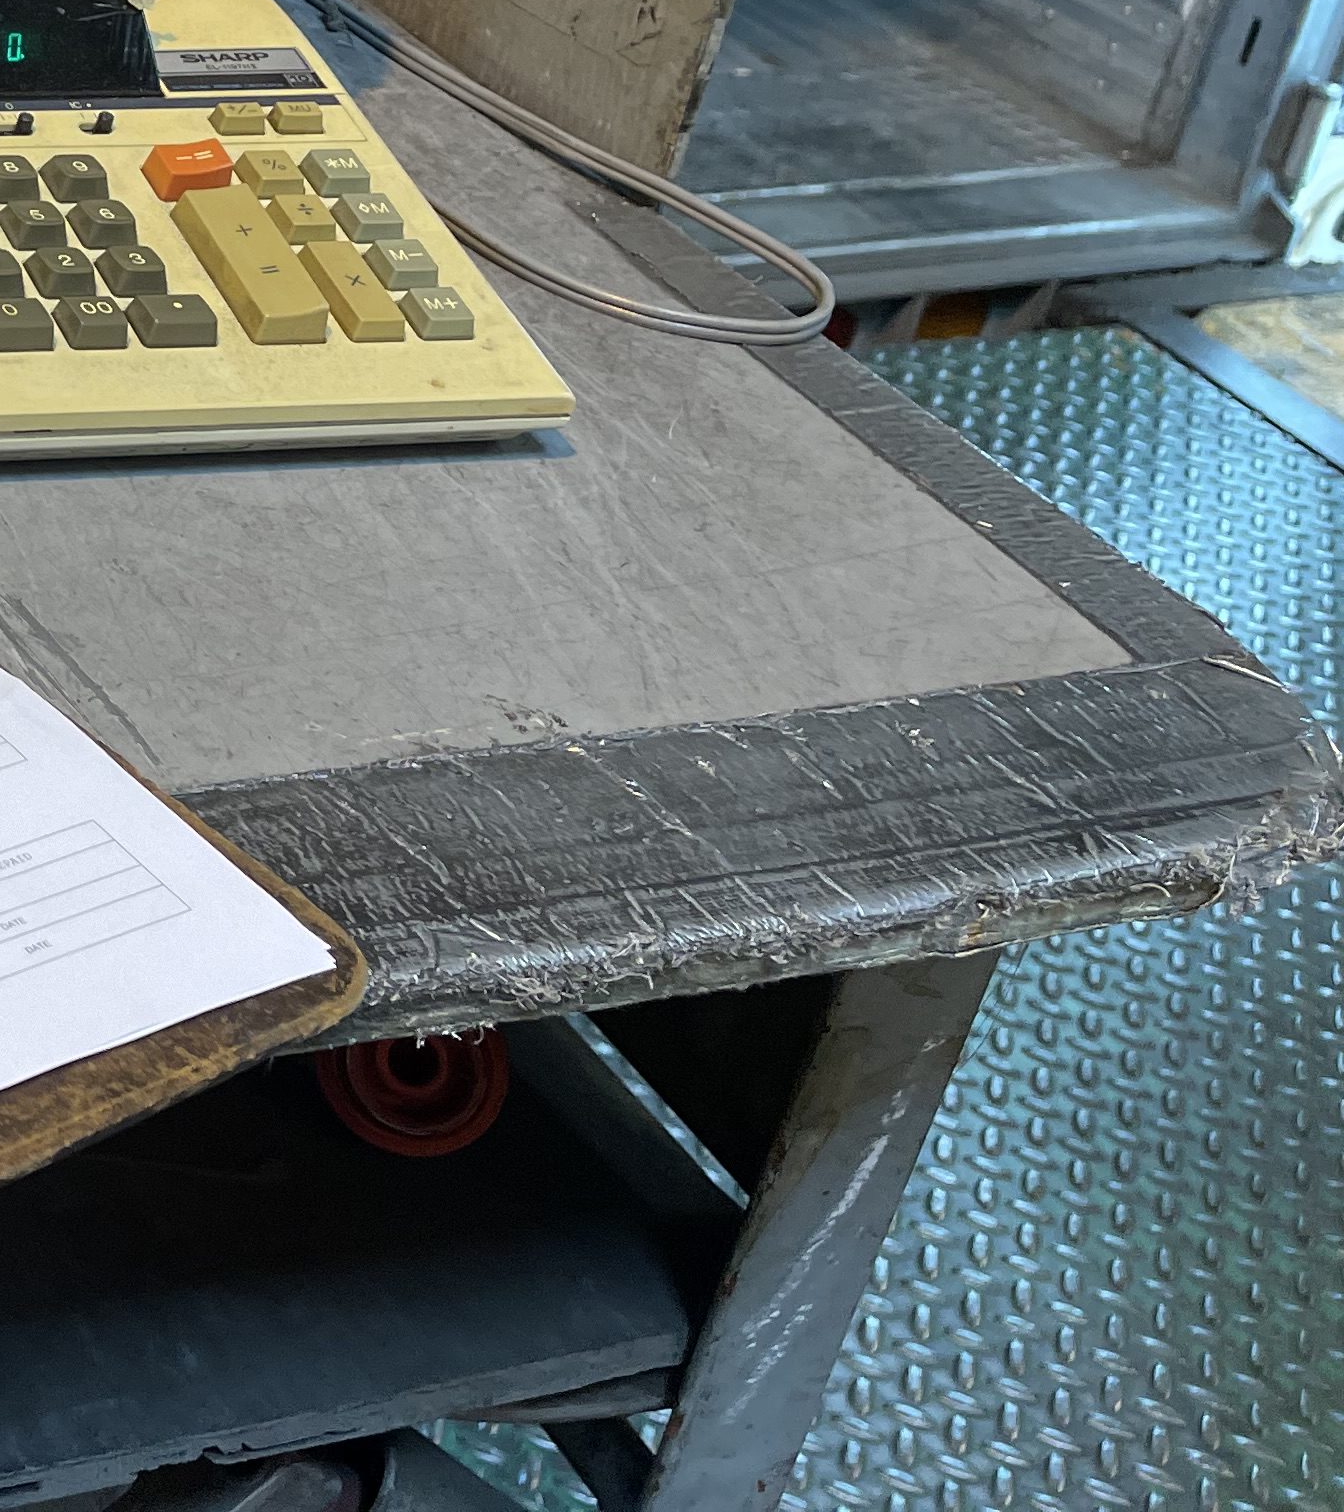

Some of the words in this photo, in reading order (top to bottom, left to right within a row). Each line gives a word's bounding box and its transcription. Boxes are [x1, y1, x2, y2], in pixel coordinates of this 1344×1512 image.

[180, 52, 269, 63] SHARP
[4, 160, 20, 174] 8
[72, 160, 88, 174] 9
[29, 209, 44, 222] 5
[100, 207, 116, 220] 6
[57, 254, 73, 267] 2
[130, 252, 145, 266] 3
[79, 301, 114, 316] 00
